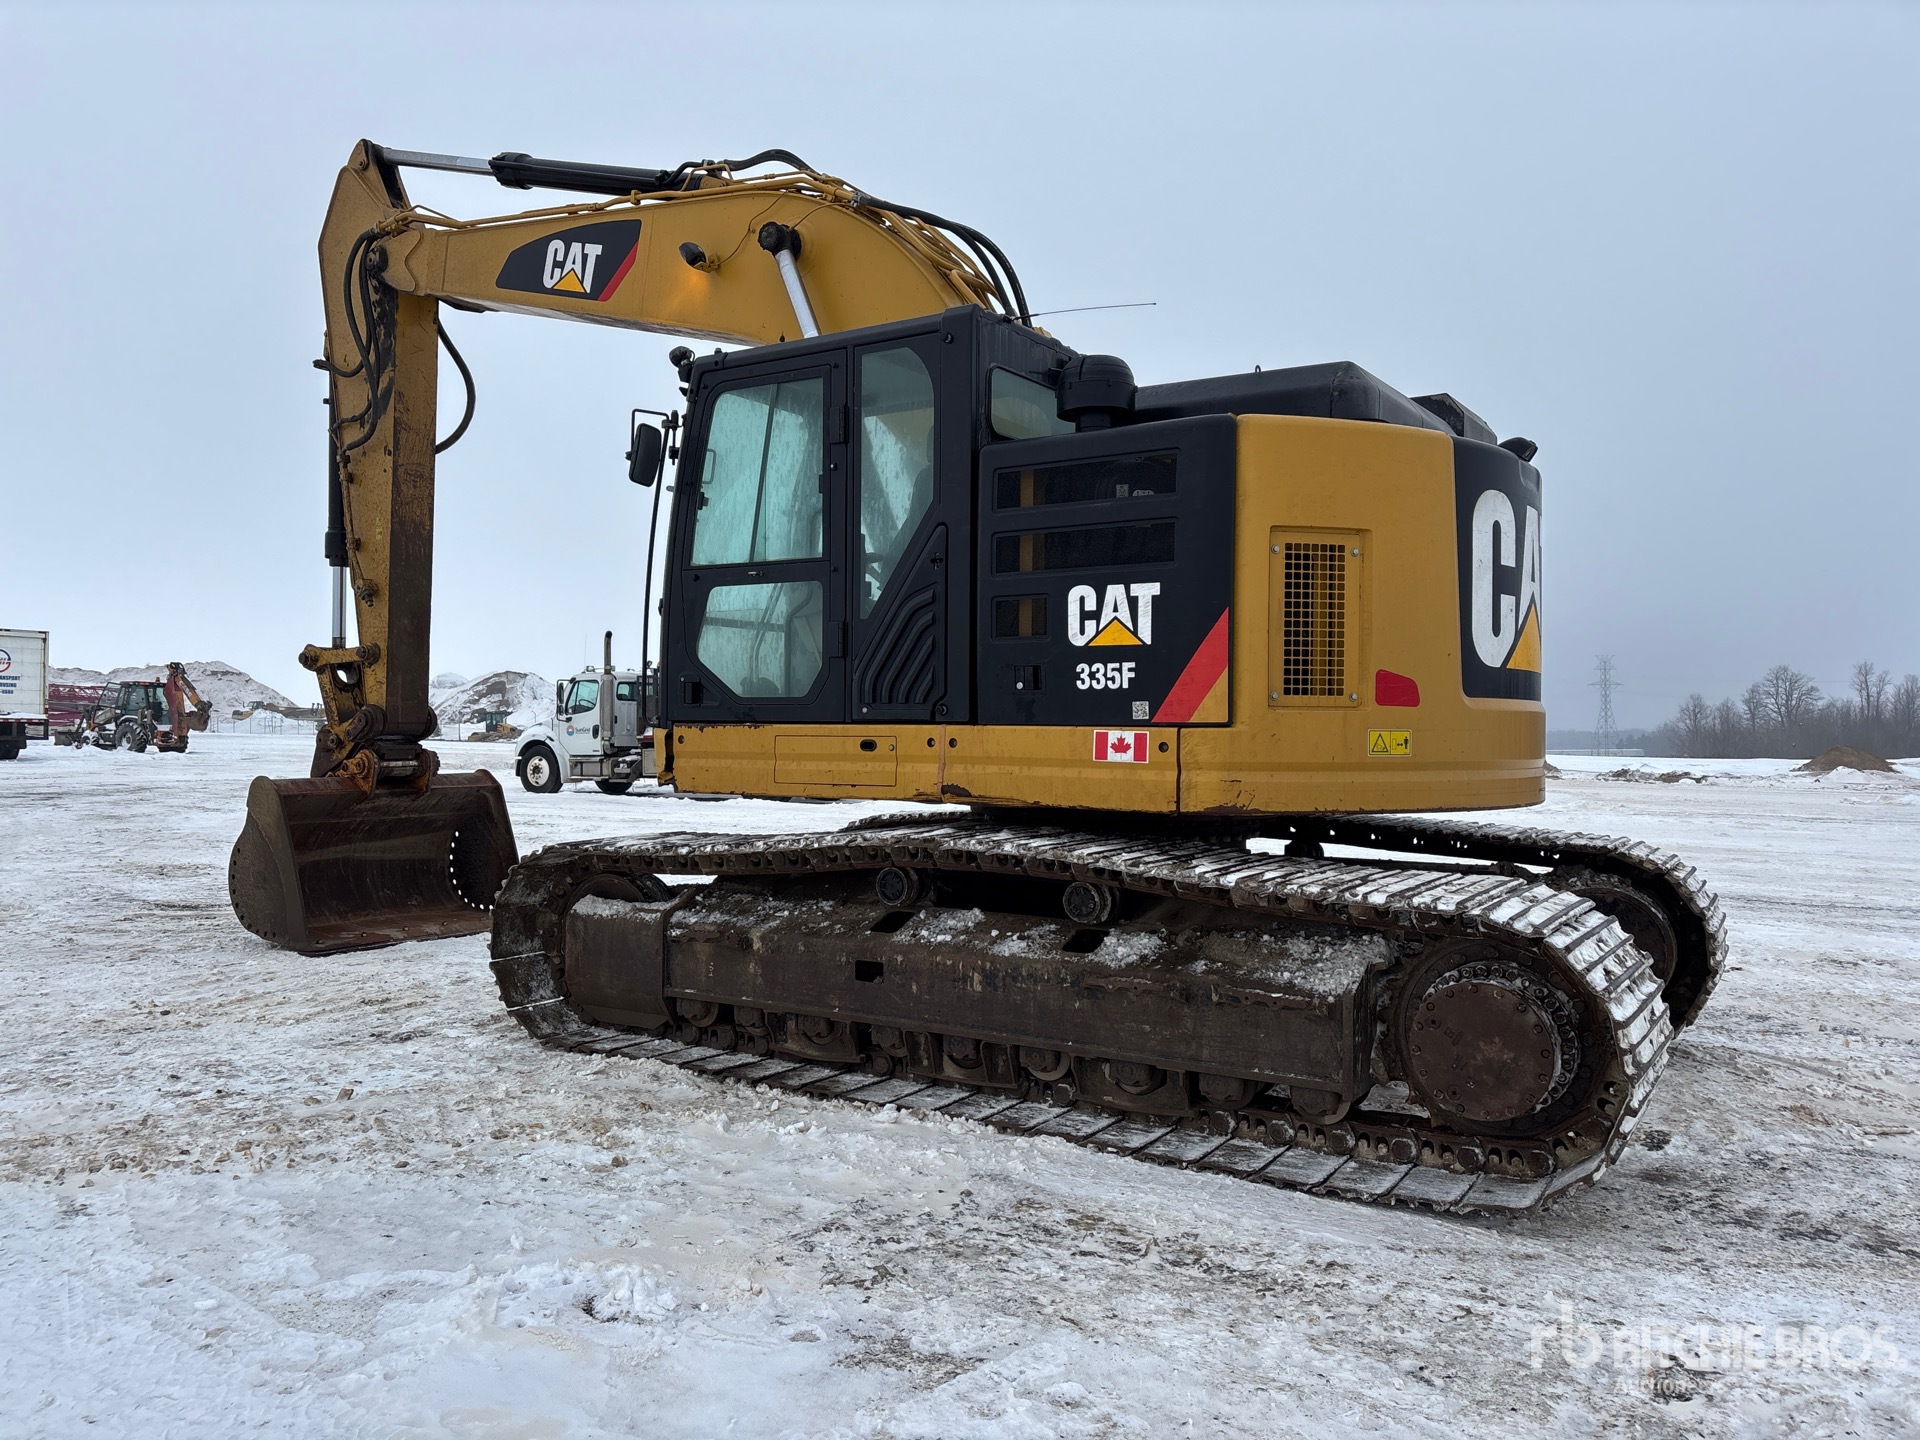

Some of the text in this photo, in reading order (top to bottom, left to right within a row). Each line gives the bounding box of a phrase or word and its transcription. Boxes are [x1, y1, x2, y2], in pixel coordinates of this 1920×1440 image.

[542, 239, 603, 294] CAT
[1472, 490, 1542, 668] CA
[1068, 582, 1161, 647] CAT
[1076, 661, 1136, 690] 335F
